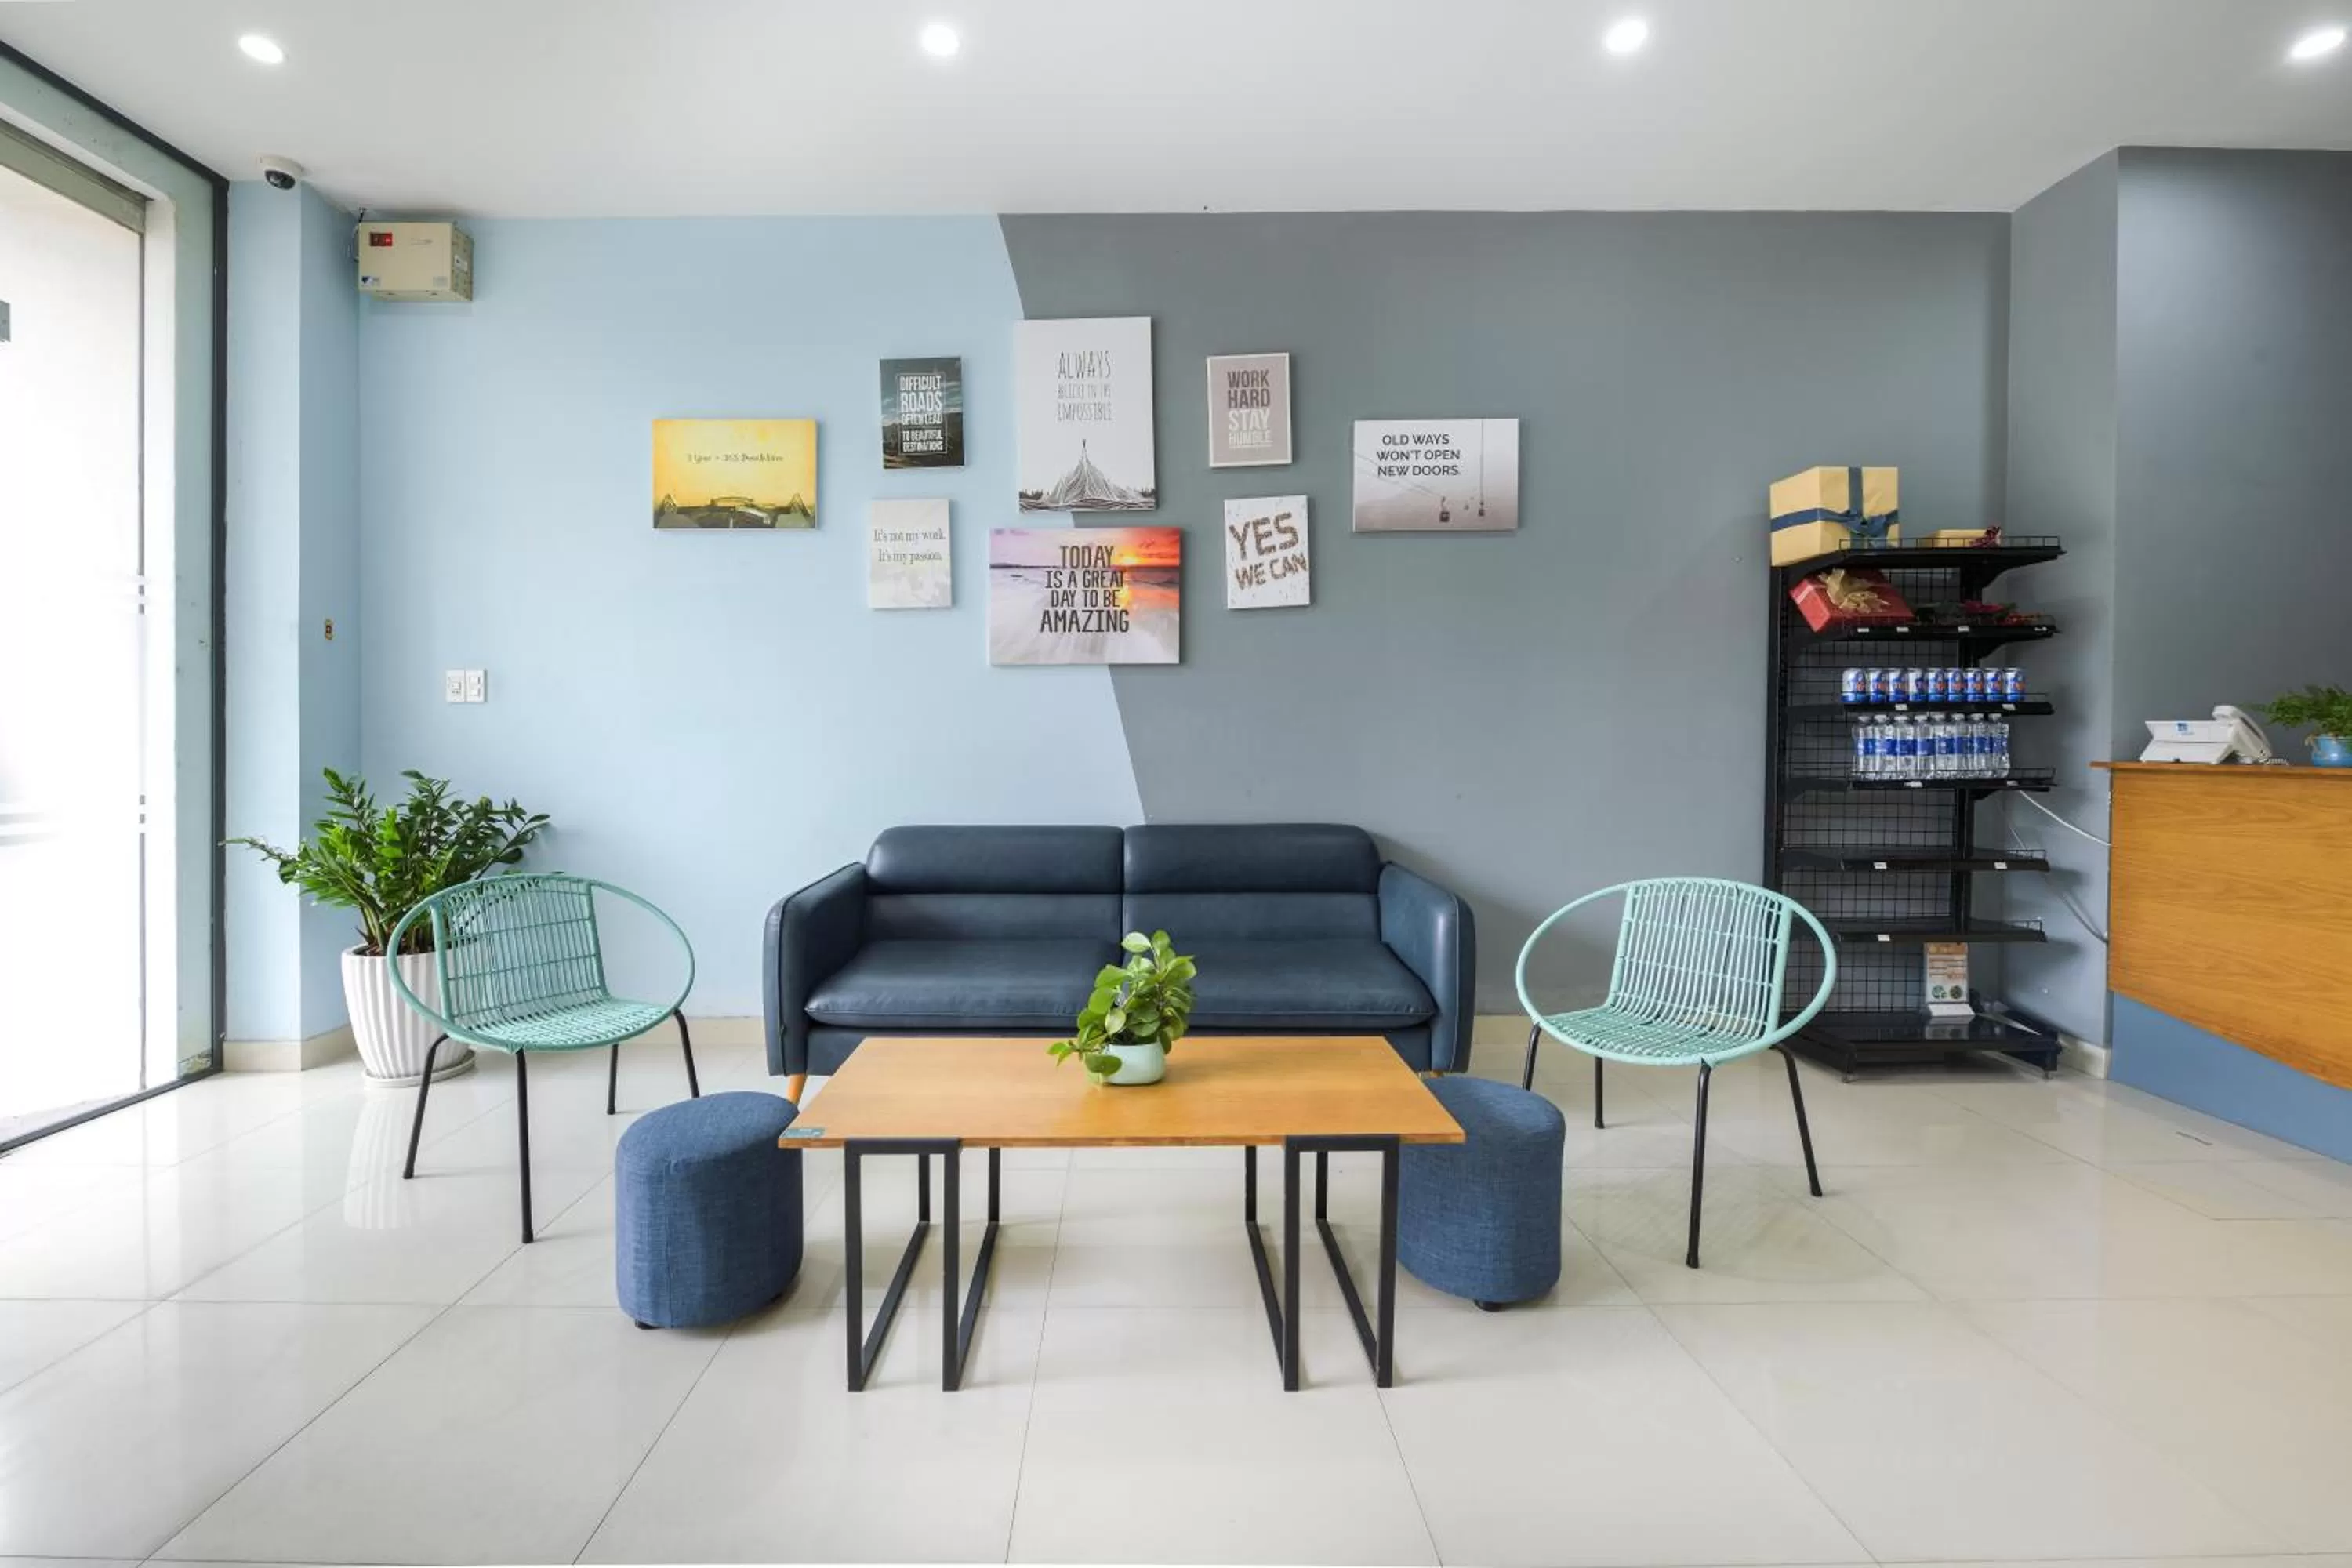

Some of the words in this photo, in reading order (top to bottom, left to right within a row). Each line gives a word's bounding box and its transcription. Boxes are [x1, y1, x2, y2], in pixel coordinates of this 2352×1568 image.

[1058, 350, 1111, 379] ALWAYS
[899, 376, 941, 391] DIFFICULT
[1227, 370, 1269, 388] WORK
[900, 392, 942, 413] ROADS
[1228, 389, 1270, 408] HARD
[1229, 408, 1270, 431] STAY
[1382, 434, 1409, 446] OLD
[1412, 434, 1450, 445] WAYS
[1376, 450, 1421, 461] WON'T
[1424, 449, 1461, 460] OPEN
[1377, 466, 1410, 477] NEW
[873, 529, 887, 542] It's
[890, 532, 903, 541] not
[906, 532, 919, 546] my
[1229, 512, 1298, 561] YES
[878, 549, 891, 563] It's
[893, 553, 907, 565] my
[1059, 545, 1114, 569] TODAY
[1044, 571, 1062, 589] IS
[1067, 571, 1078, 588] A
[1083, 570, 1125, 588] GREAT
[1235, 562, 1267, 590] WE
[1269, 551, 1307, 580] CAN
[1051, 590, 1076, 608] DAY
[1082, 590, 1098, 607] TO
[1103, 590, 1120, 608] BE
[1040, 609, 1130, 633] AMAZING
